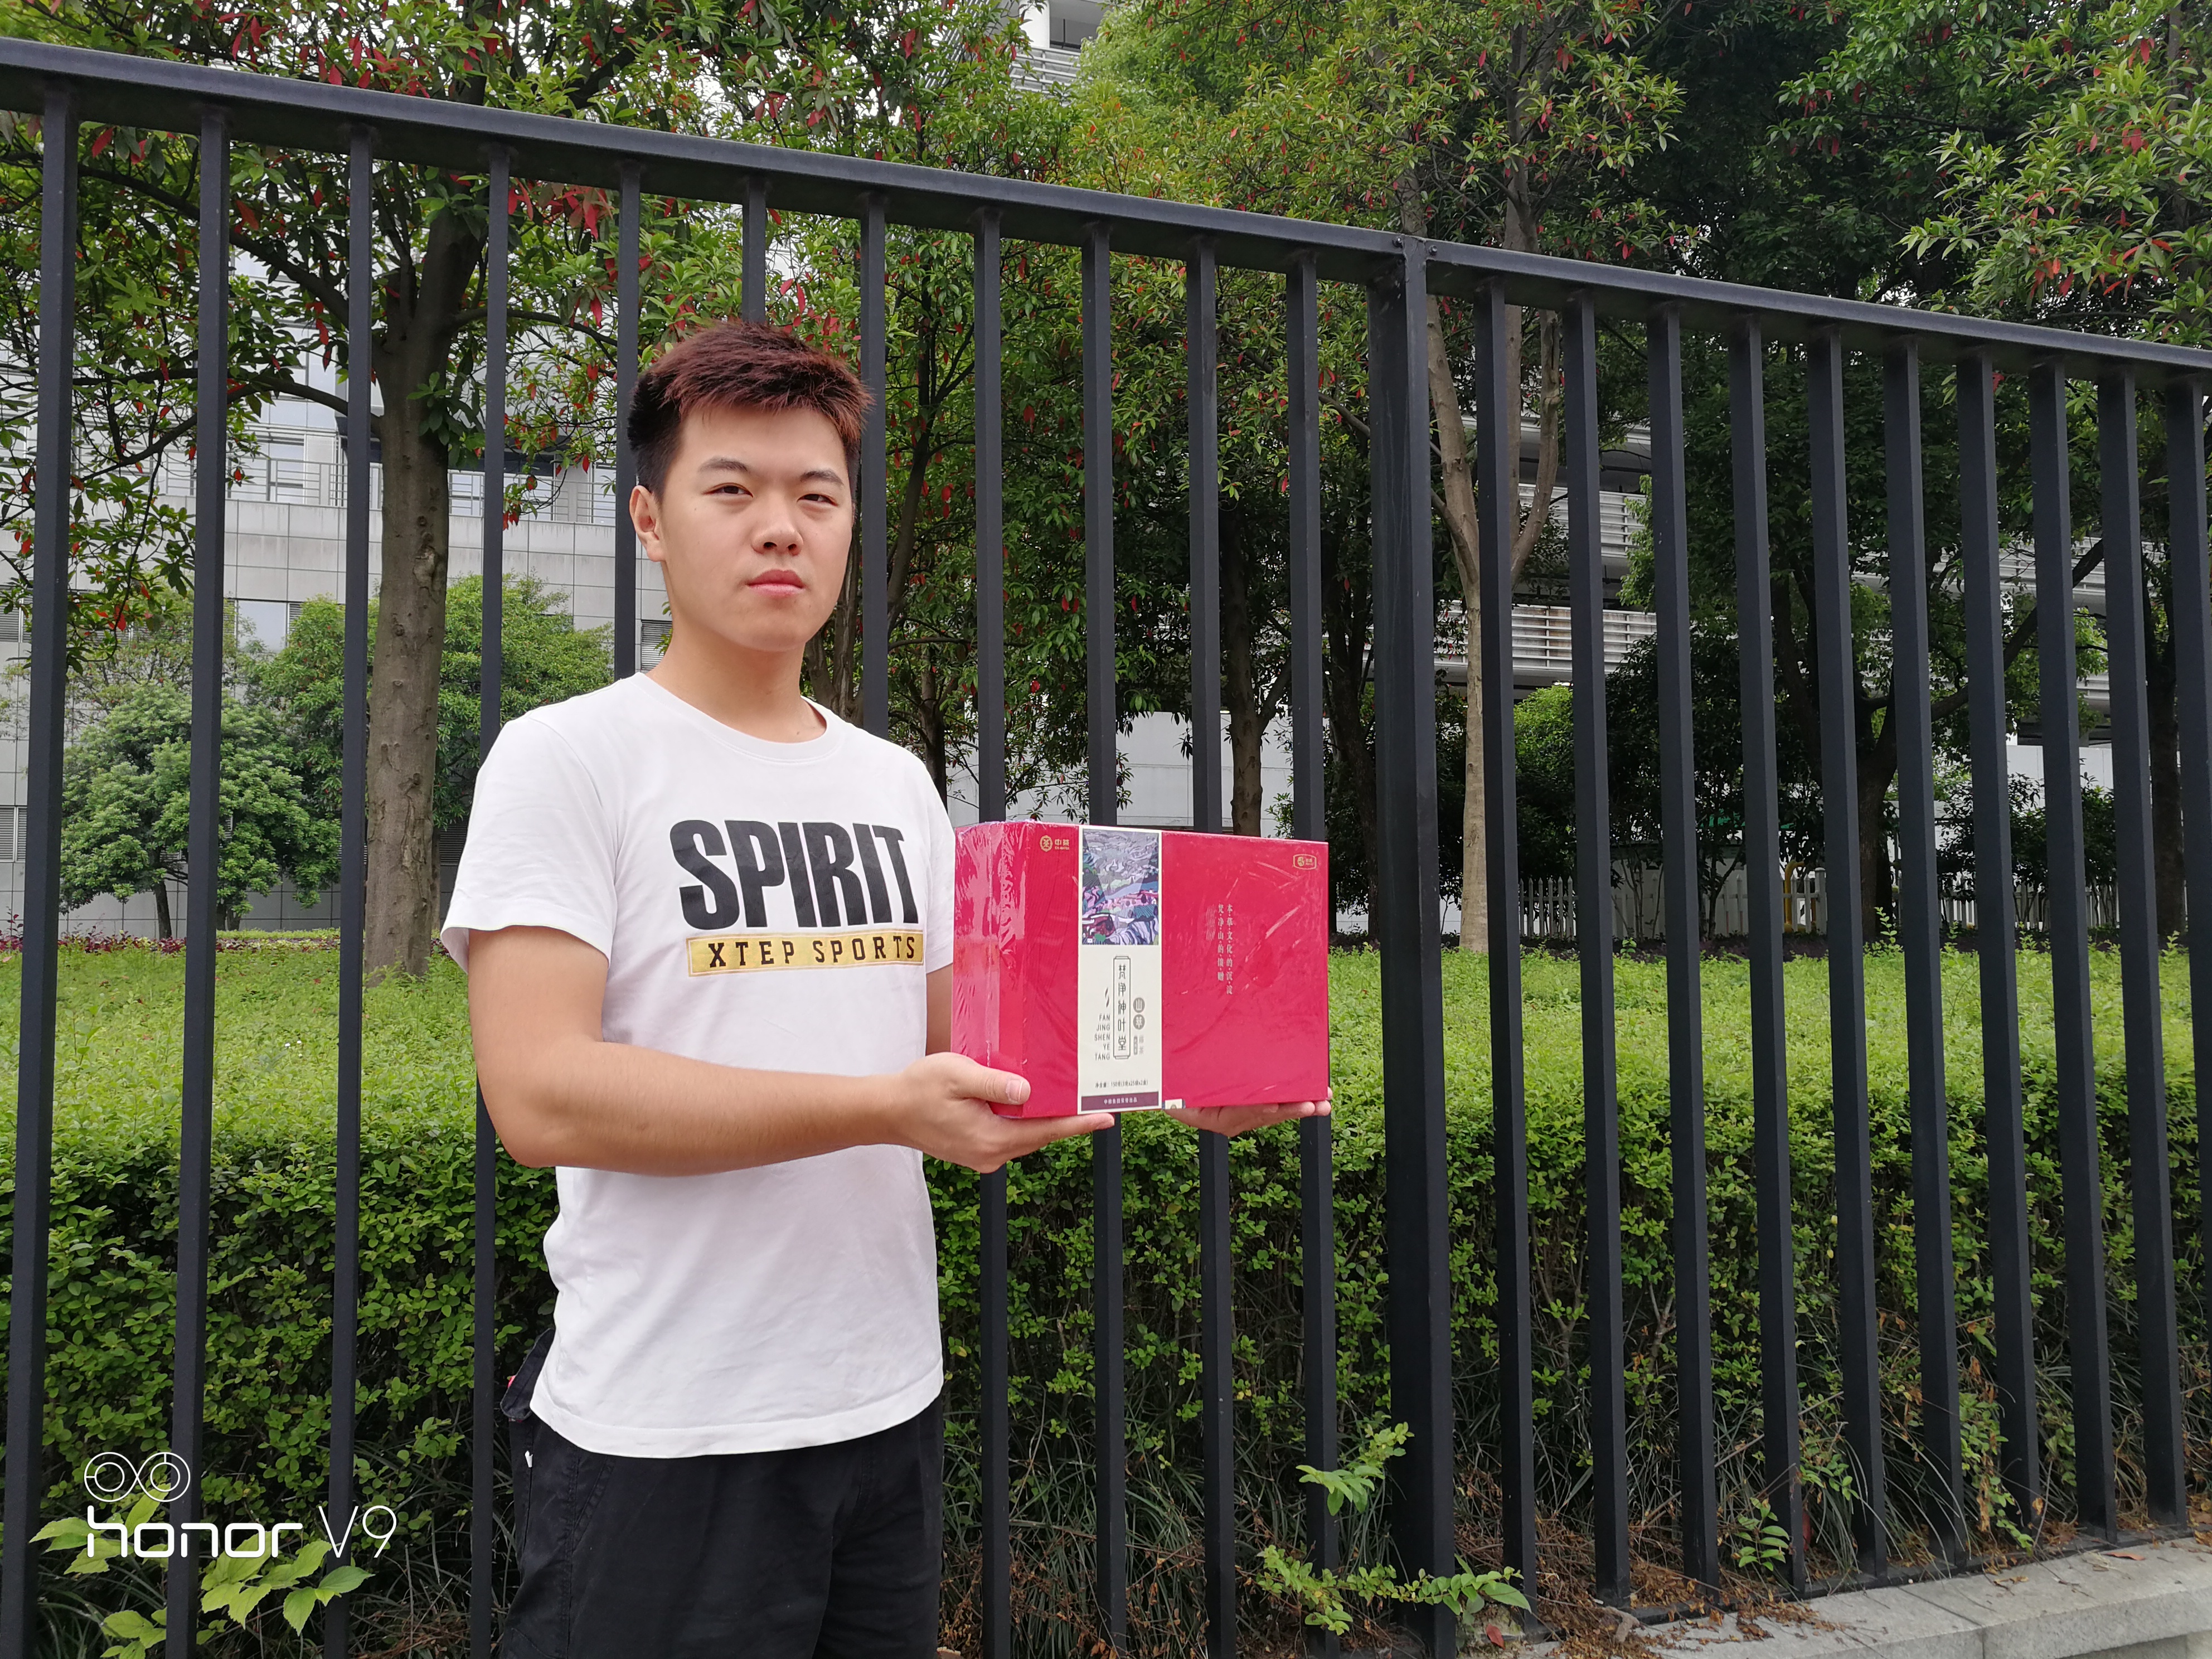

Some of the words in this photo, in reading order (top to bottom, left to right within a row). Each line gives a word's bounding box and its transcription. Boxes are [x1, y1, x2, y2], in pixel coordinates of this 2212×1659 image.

[670, 819, 919, 930] SPIRIT
[708, 940, 794, 968] XTEP
[812, 935, 915, 963] SPORTS
